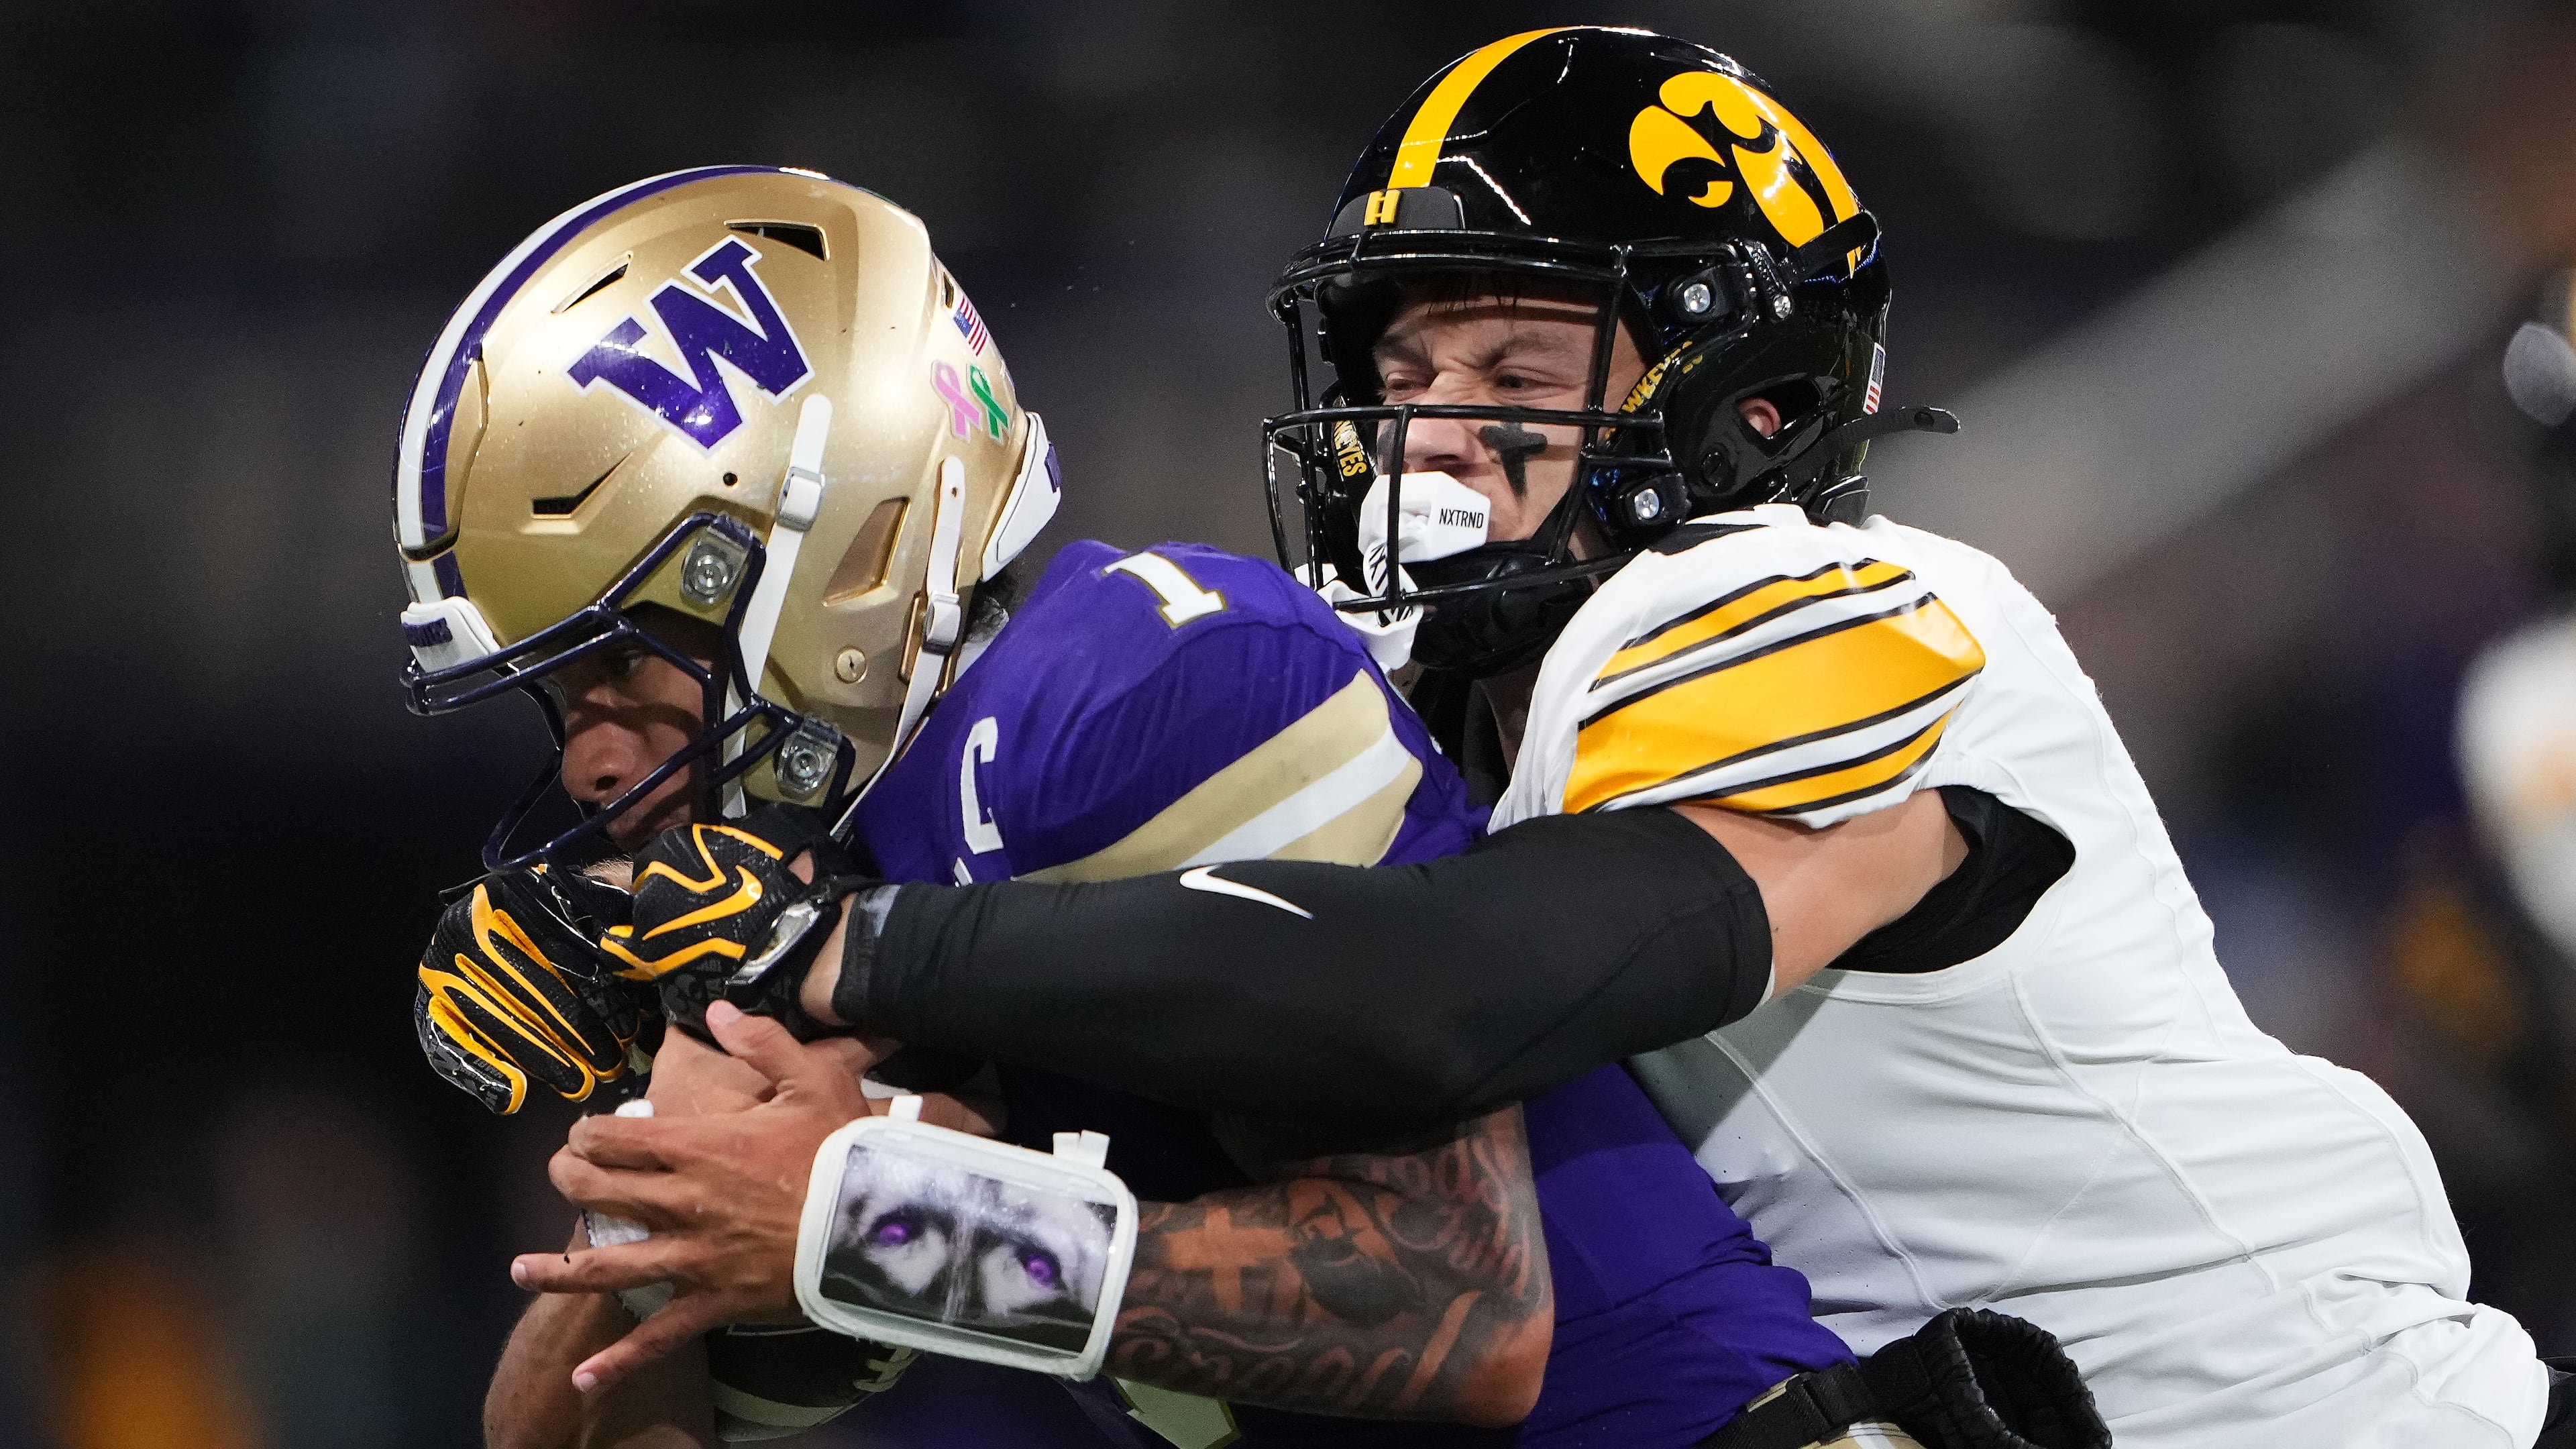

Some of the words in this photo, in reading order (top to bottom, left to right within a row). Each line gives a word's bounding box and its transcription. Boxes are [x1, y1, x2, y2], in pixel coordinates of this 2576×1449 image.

[562, 235, 814, 458] W
[1439, 508, 1484, 529] NXTRND
[1101, 551, 1228, 629] 1
